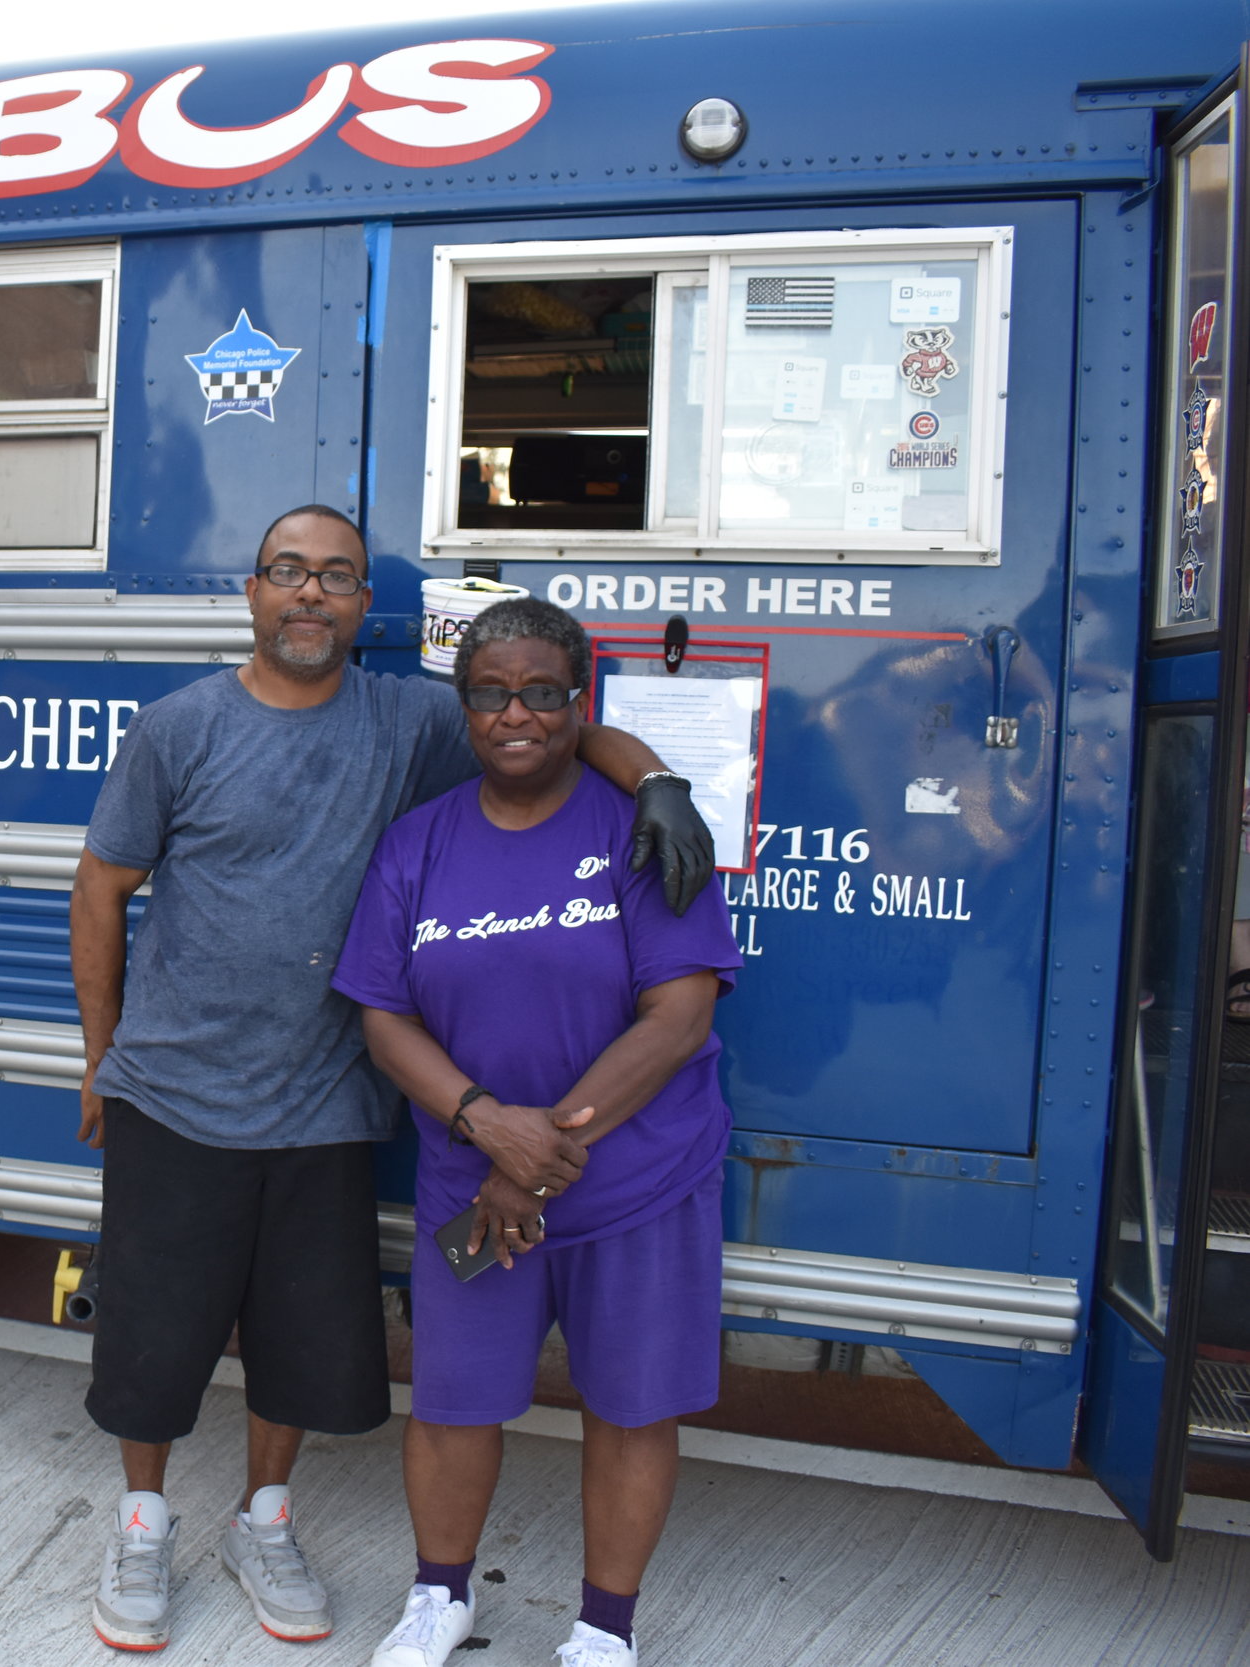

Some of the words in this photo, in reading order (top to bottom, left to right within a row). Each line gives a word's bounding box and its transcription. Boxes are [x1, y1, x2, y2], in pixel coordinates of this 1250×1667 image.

[916, 288, 953, 300] Square
[215, 350, 246, 360] Chicago
[248, 348, 270, 357] Police
[203, 361, 238, 369] Memorial
[239, 358, 281, 368] Foundation
[238, 399, 267, 408] forget
[889, 448, 958, 468] CHAMPIONS
[547, 574, 726, 612] ORDER
[746, 578, 892, 616] HERE
[724, 867, 820, 911] LARGE
[834, 871, 856, 914] &
[870, 873, 972, 921] SMALL
[412, 918, 451, 952] The
[456, 905, 553, 940] Lunch
[559, 898, 620, 928] Bus
